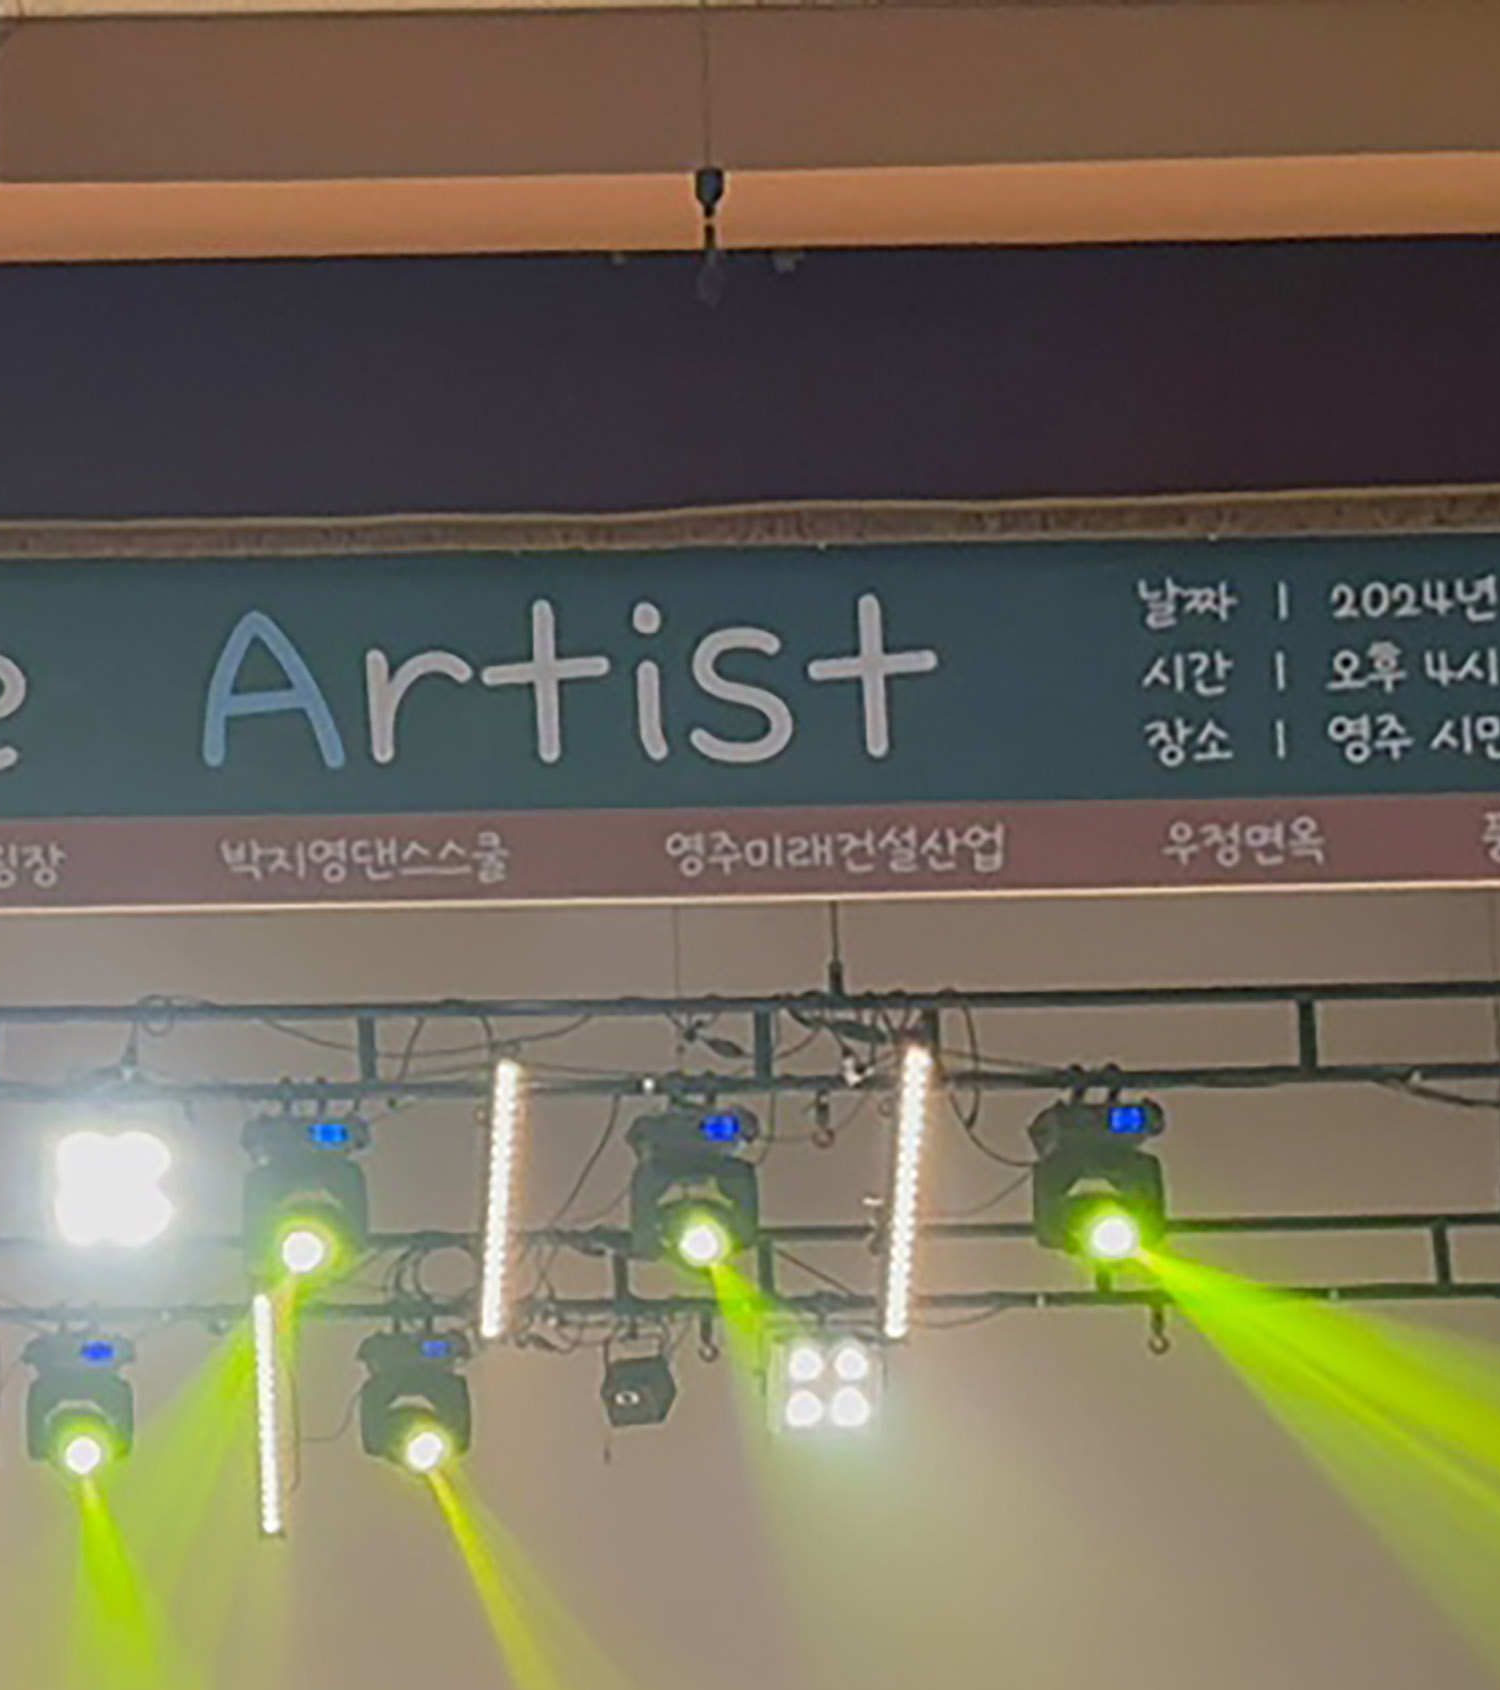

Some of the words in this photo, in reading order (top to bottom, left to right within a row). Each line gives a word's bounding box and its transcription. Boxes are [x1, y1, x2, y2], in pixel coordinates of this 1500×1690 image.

[1137, 577, 1238, 629] 날짜
[1331, 574, 1498, 622] 2024년
[203, 593, 940, 770] Artist
[1142, 650, 1234, 697] 시간
[1326, 640, 1408, 693] 오후
[1424, 647, 1499, 687] 4시
[1144, 717, 1234, 768] 장소
[1327, 713, 1415, 764] 영주
[220, 831, 509, 883] 박지영댄스스쿨
[665, 821, 1005, 877] 영주미래건설산업
